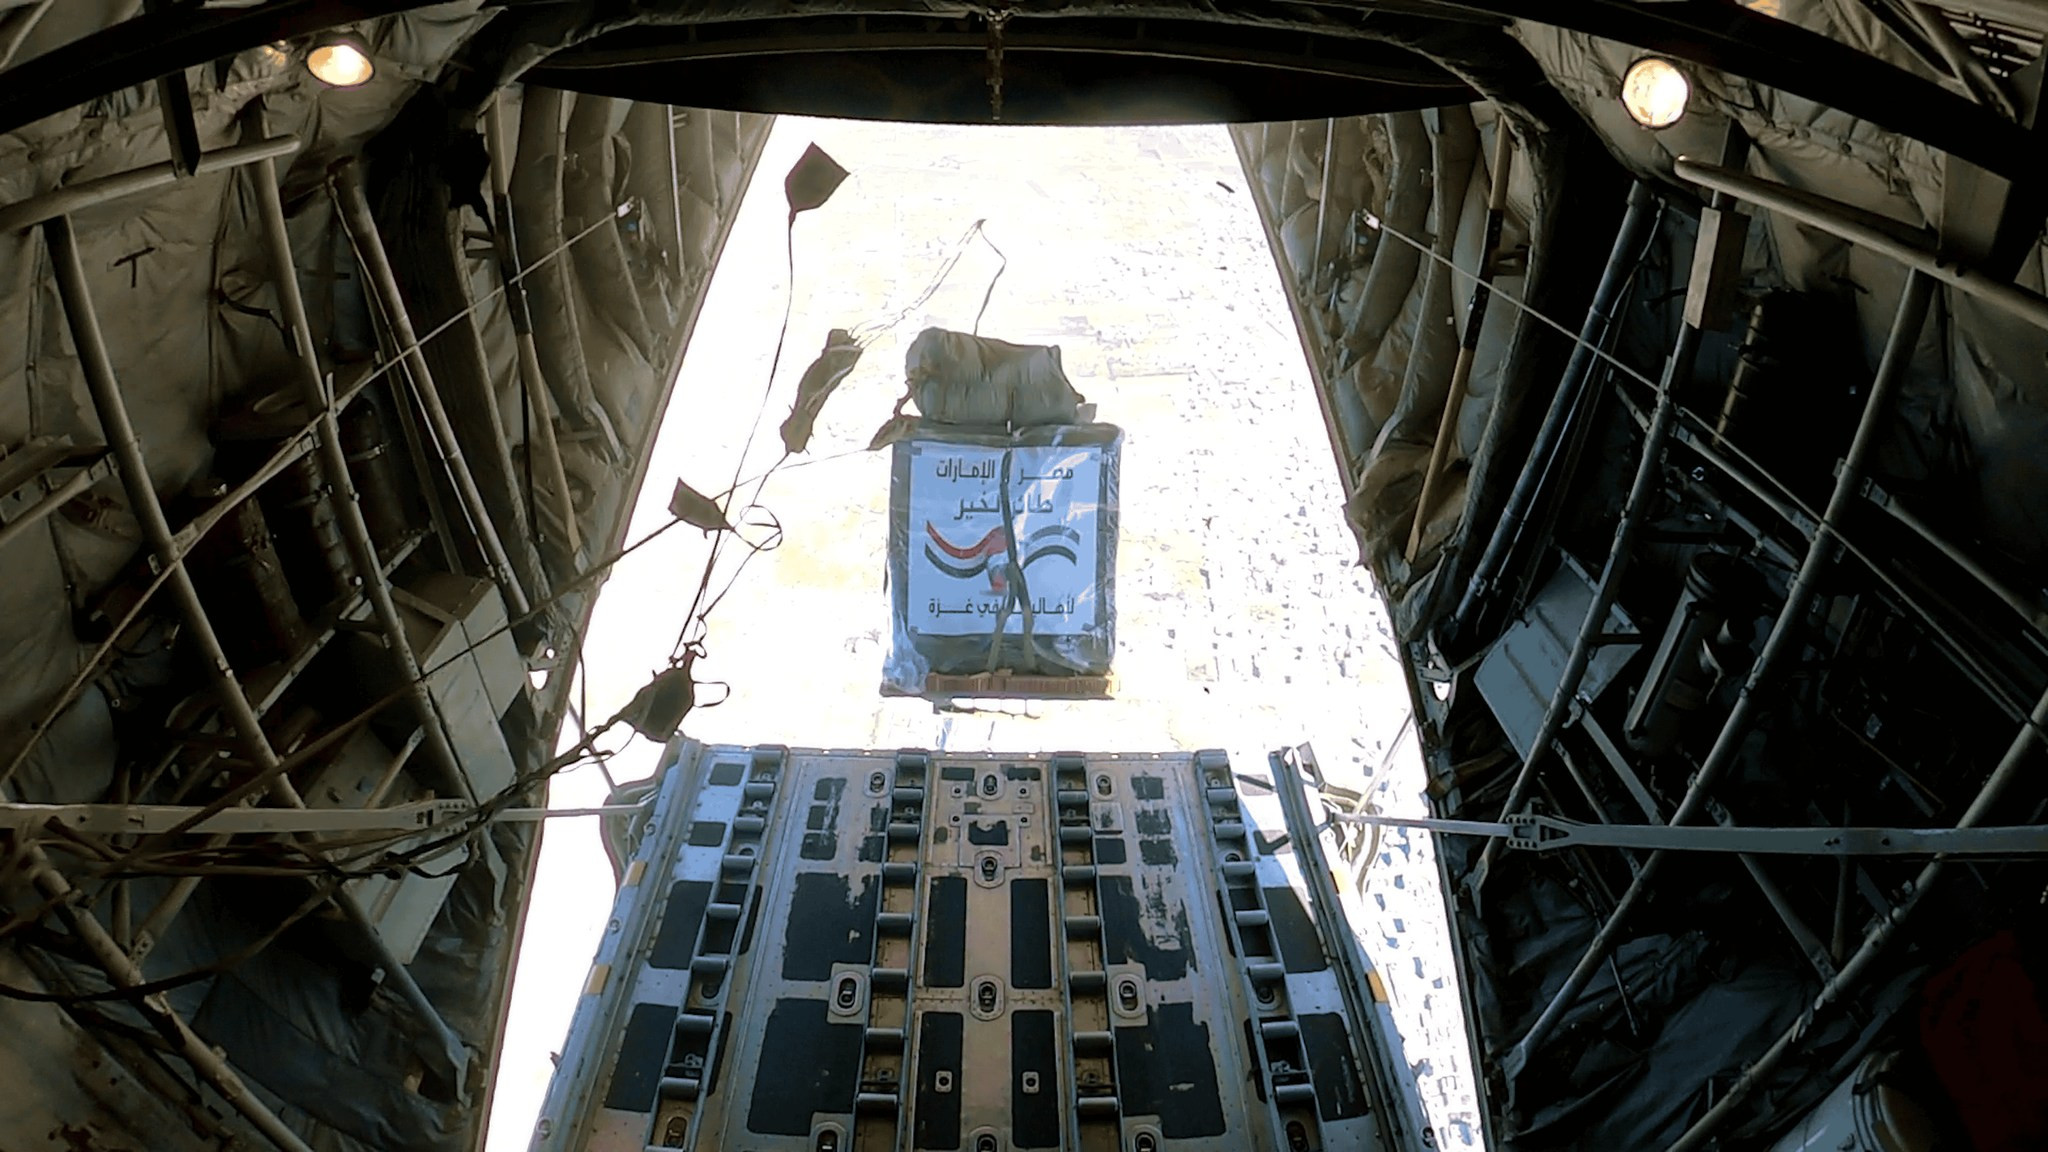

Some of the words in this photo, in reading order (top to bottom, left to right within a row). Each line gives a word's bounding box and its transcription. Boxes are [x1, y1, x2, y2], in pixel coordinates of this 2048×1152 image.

[1018, 467, 1073, 485] مصر
[953, 491, 1001, 520] لخير
[929, 598, 973, 618] غزة
